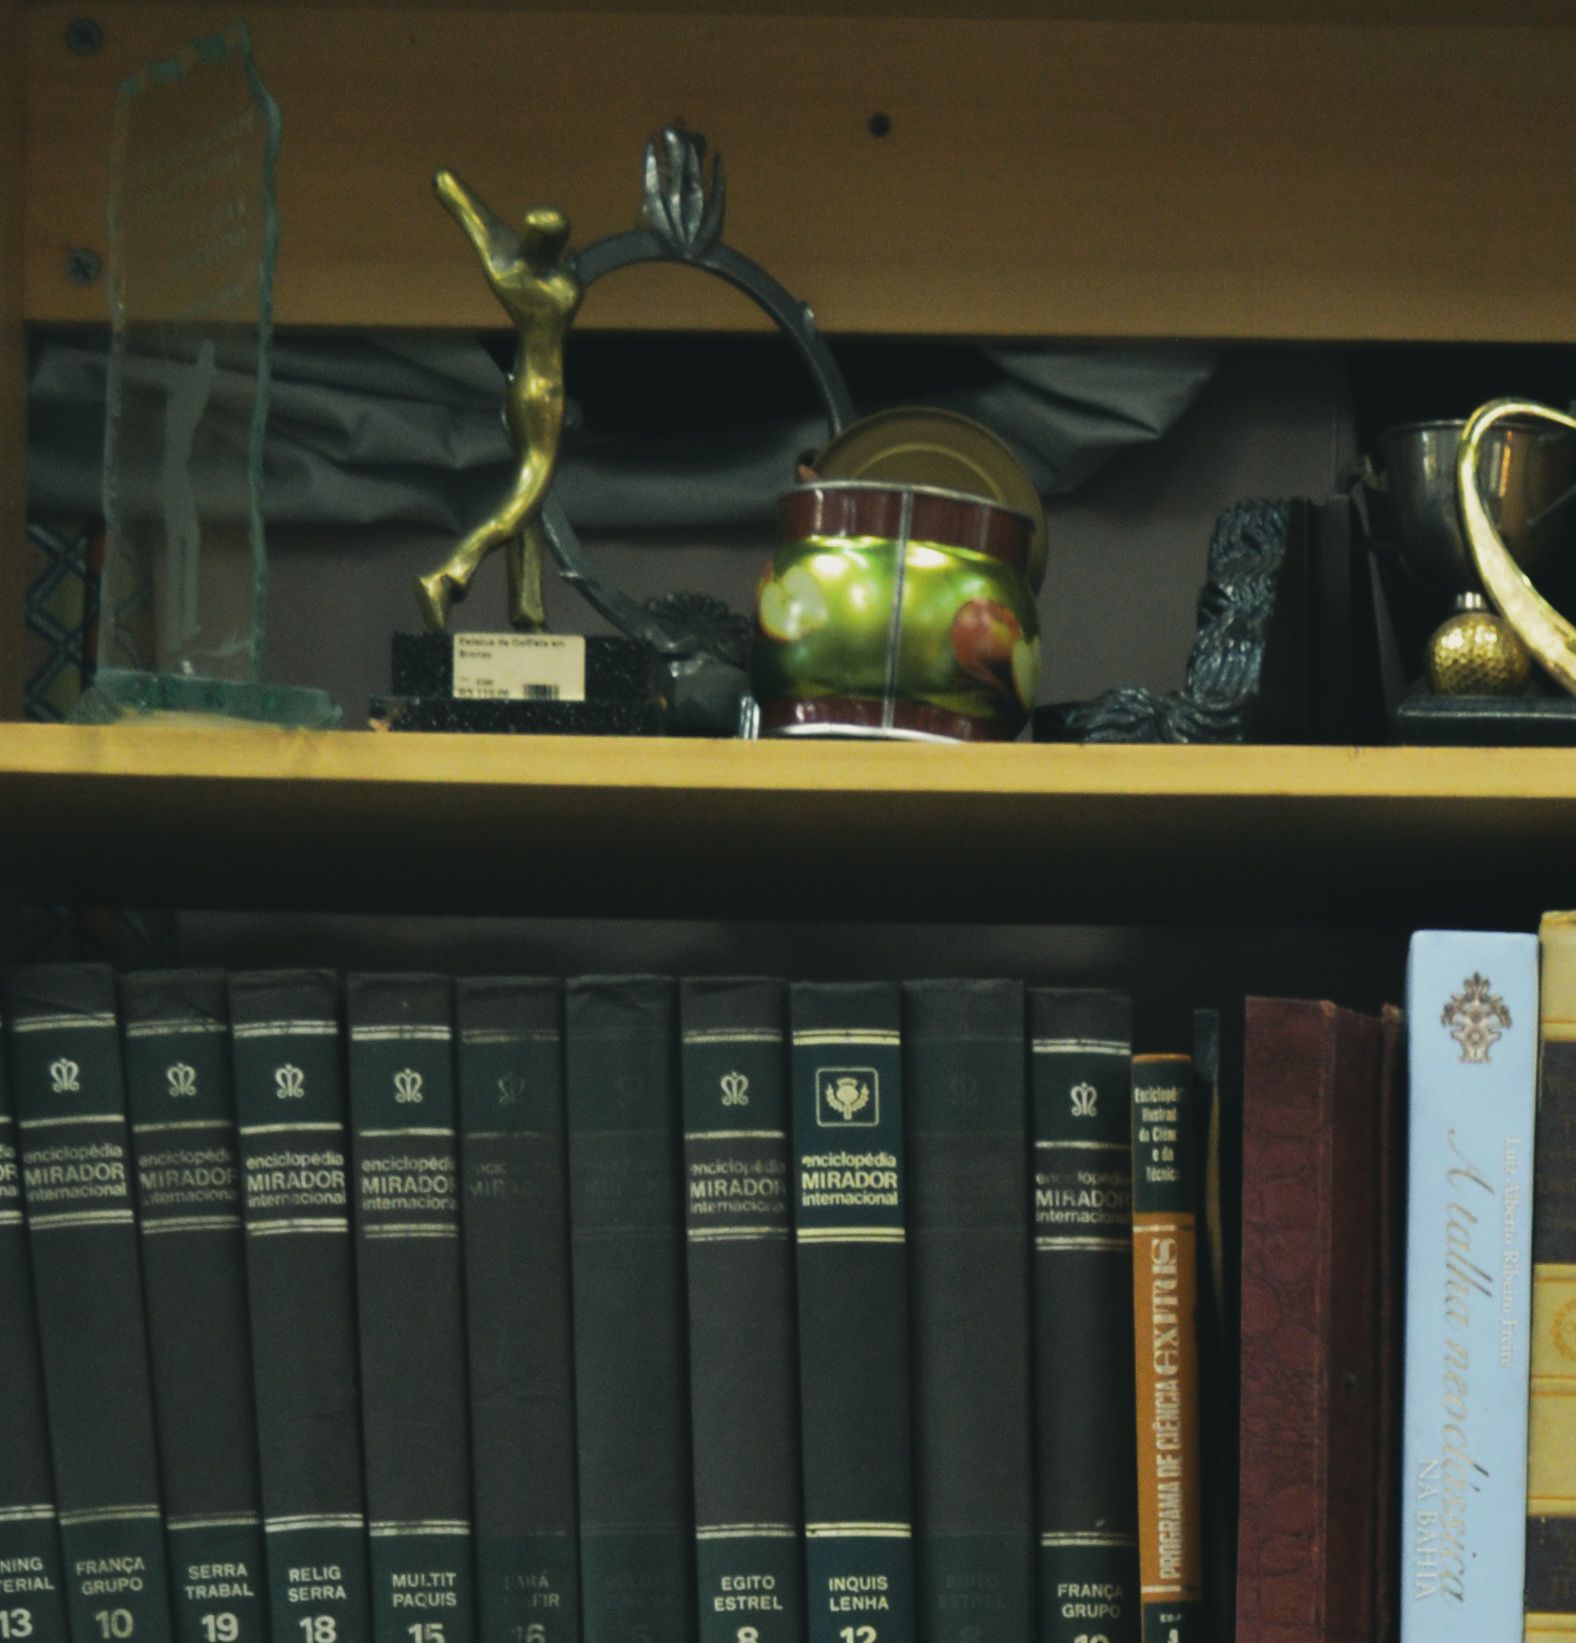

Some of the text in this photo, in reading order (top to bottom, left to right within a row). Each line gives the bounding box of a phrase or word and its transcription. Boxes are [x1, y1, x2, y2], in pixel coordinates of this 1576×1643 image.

[24, 1163, 124, 1183] MIRADOR
[247, 1170, 346, 1192] MIRADOR
[802, 1172, 897, 1190] MIRADOR
[1444, 1201, 1493, 1321] talha
[1501, 1250, 1519, 1314] Ribeiro
[1160, 1447, 1180, 1480] DE
[1441, 1339, 1490, 1604] neoclássica
[1160, 1481, 1182, 1580] PROGRAMA
[1414, 1458, 1440, 1600] NA BAHIA
[75, 1557, 145, 1577] FRANÇA
[187, 1563, 248, 1580] SERRA
[288, 1565, 342, 1583] RELIG
[81, 1576, 143, 1595] GRUPO
[391, 1571, 457, 1588] MULTIT
[721, 1575, 775, 1592] EGITO
[828, 1576, 889, 1593] INQUIS
[185, 1582, 254, 1599] TRABAL
[288, 1584, 347, 1602] SERRA
[1057, 1583, 1123, 1601] FRANÇA
[714, 1595, 784, 1612] ESTREL
[830, 1596, 890, 1612] LENHA
[1062, 1603, 1121, 1619] GRUPO
[97, 1610, 133, 1639] 10
[200, 1613, 240, 1643] 19
